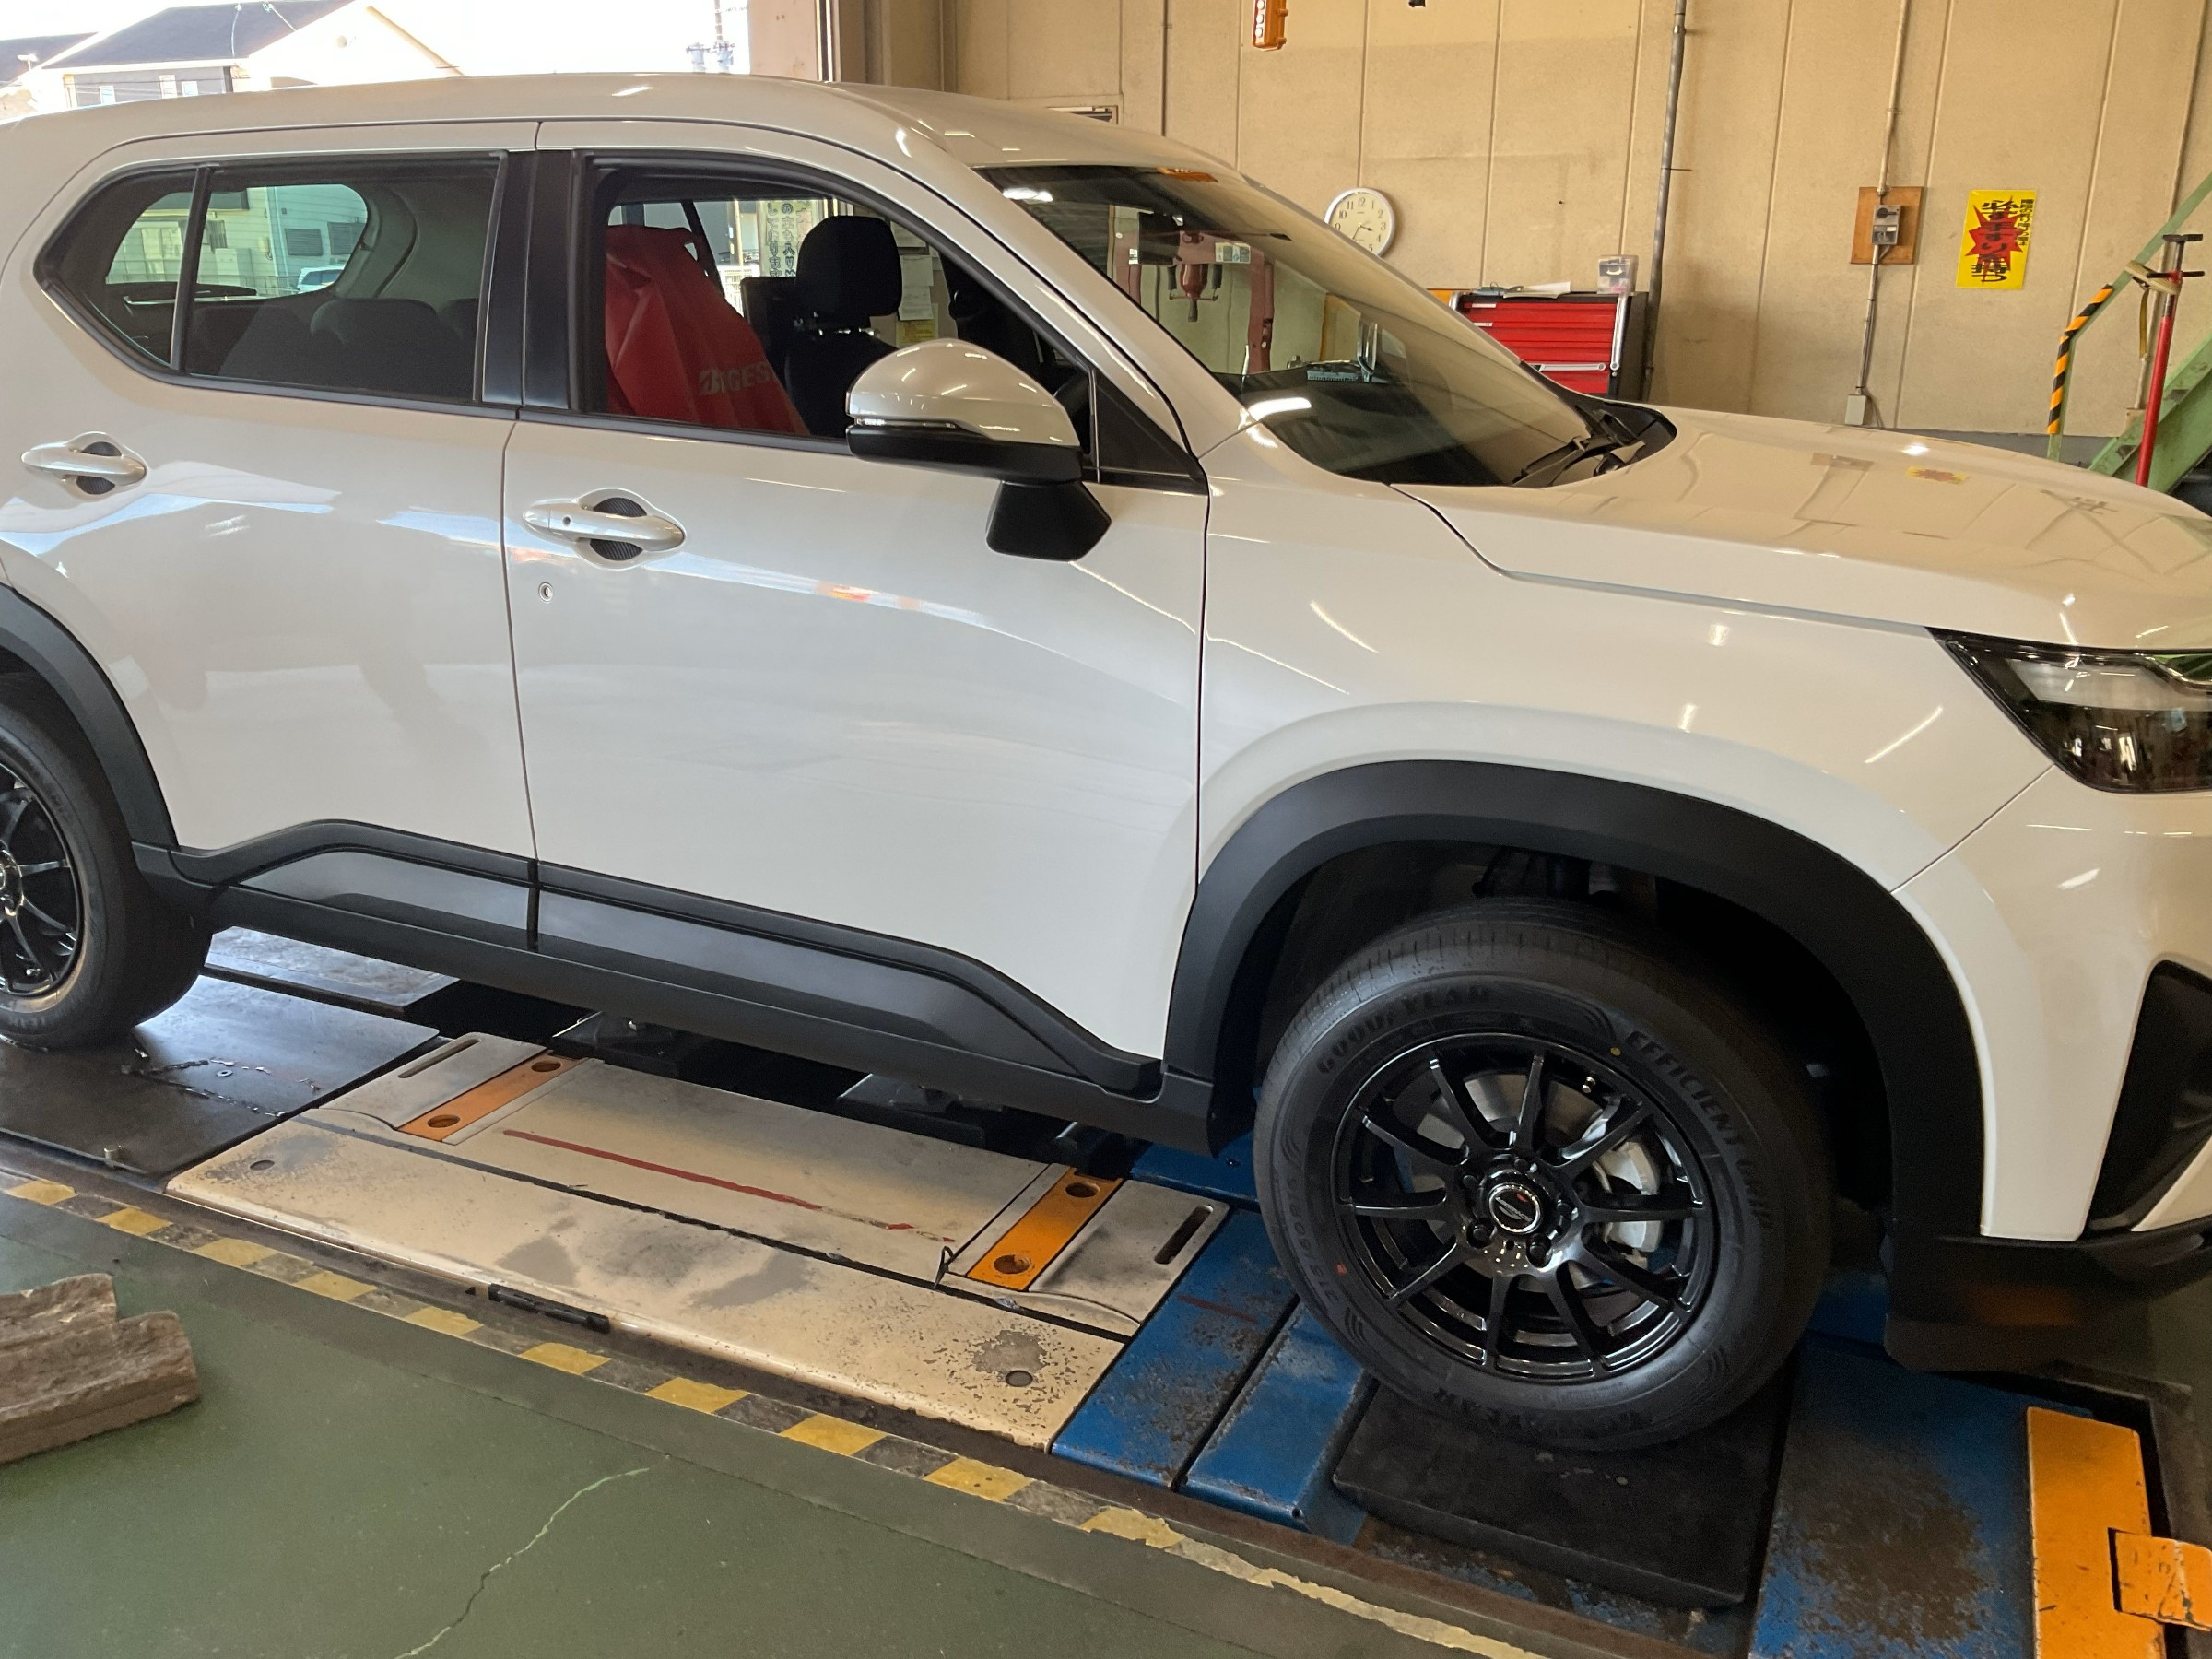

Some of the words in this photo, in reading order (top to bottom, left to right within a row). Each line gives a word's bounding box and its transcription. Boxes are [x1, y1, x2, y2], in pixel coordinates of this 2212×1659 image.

[1347, 200, 1354, 210] 11
[1358, 197, 1366, 207] 12
[1339, 209, 1347, 219] 10
[1377, 209, 1383, 219] 2
[1380, 222, 1386, 231] 3
